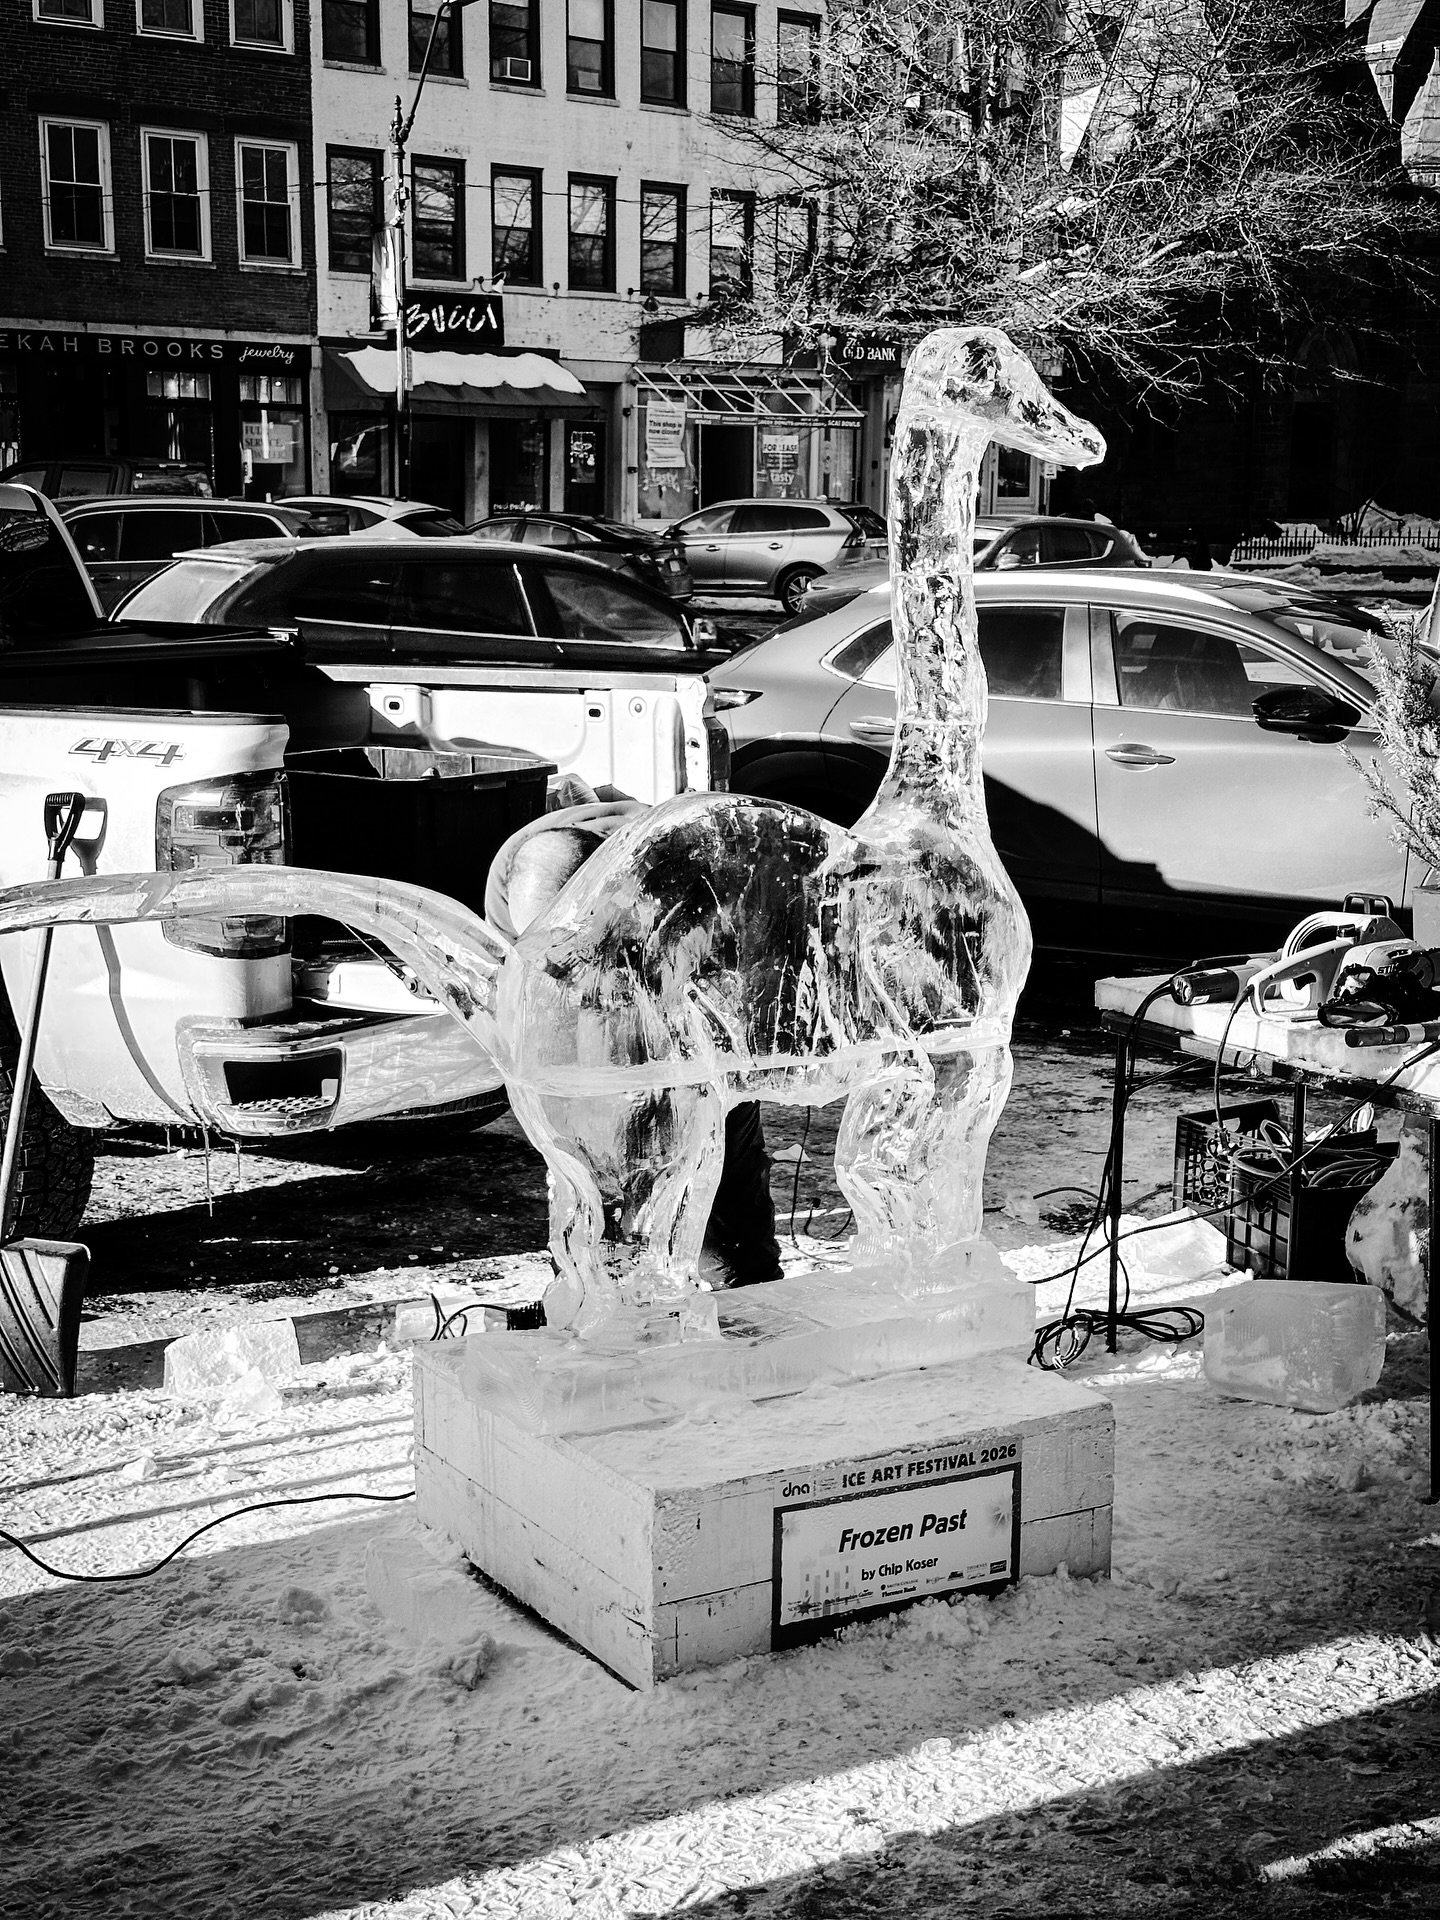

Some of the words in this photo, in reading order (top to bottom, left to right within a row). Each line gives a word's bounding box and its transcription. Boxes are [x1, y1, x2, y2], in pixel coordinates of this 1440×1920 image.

[406, 303, 498, 339] BUCCI
[98, 338, 224, 359] BROOKS
[239, 345, 296, 365] jewelry
[867, 347, 896, 361] BANK
[763, 443, 777, 452] FOR
[782, 1482, 810, 1498] dna
[842, 1471, 866, 1489] ICE
[871, 1467, 903, 1484] ART
[907, 1453, 976, 1478] FESTIVAL
[980, 1443, 1017, 1463] 2026
[838, 1523, 913, 1552] Frozen
[919, 1509, 967, 1537] Past
[861, 1569, 876, 1581] by
[878, 1563, 903, 1577] Chip
[905, 1557, 938, 1573] Koser
